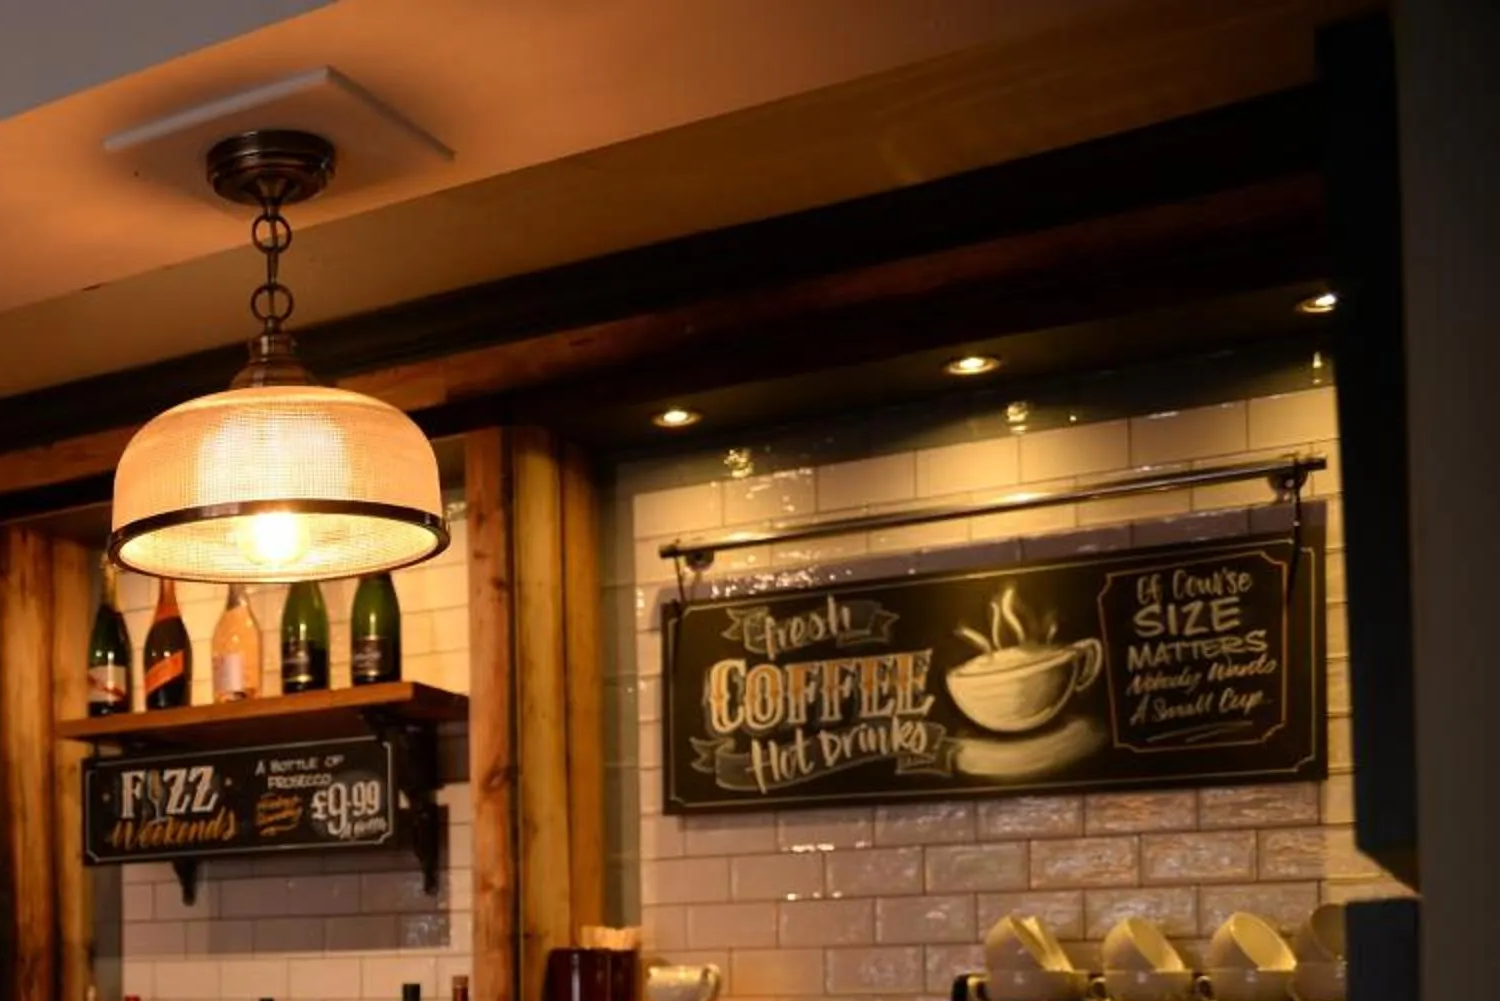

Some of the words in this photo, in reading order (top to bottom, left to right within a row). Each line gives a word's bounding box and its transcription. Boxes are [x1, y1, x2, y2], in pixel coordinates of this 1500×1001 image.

[1133, 597, 1241, 638] SIZE
[1127, 629, 1269, 673] MATTERS
[706, 649, 935, 733] COFFEE
[1218, 687, 1264, 715] Cup
[747, 728, 815, 794] Hot
